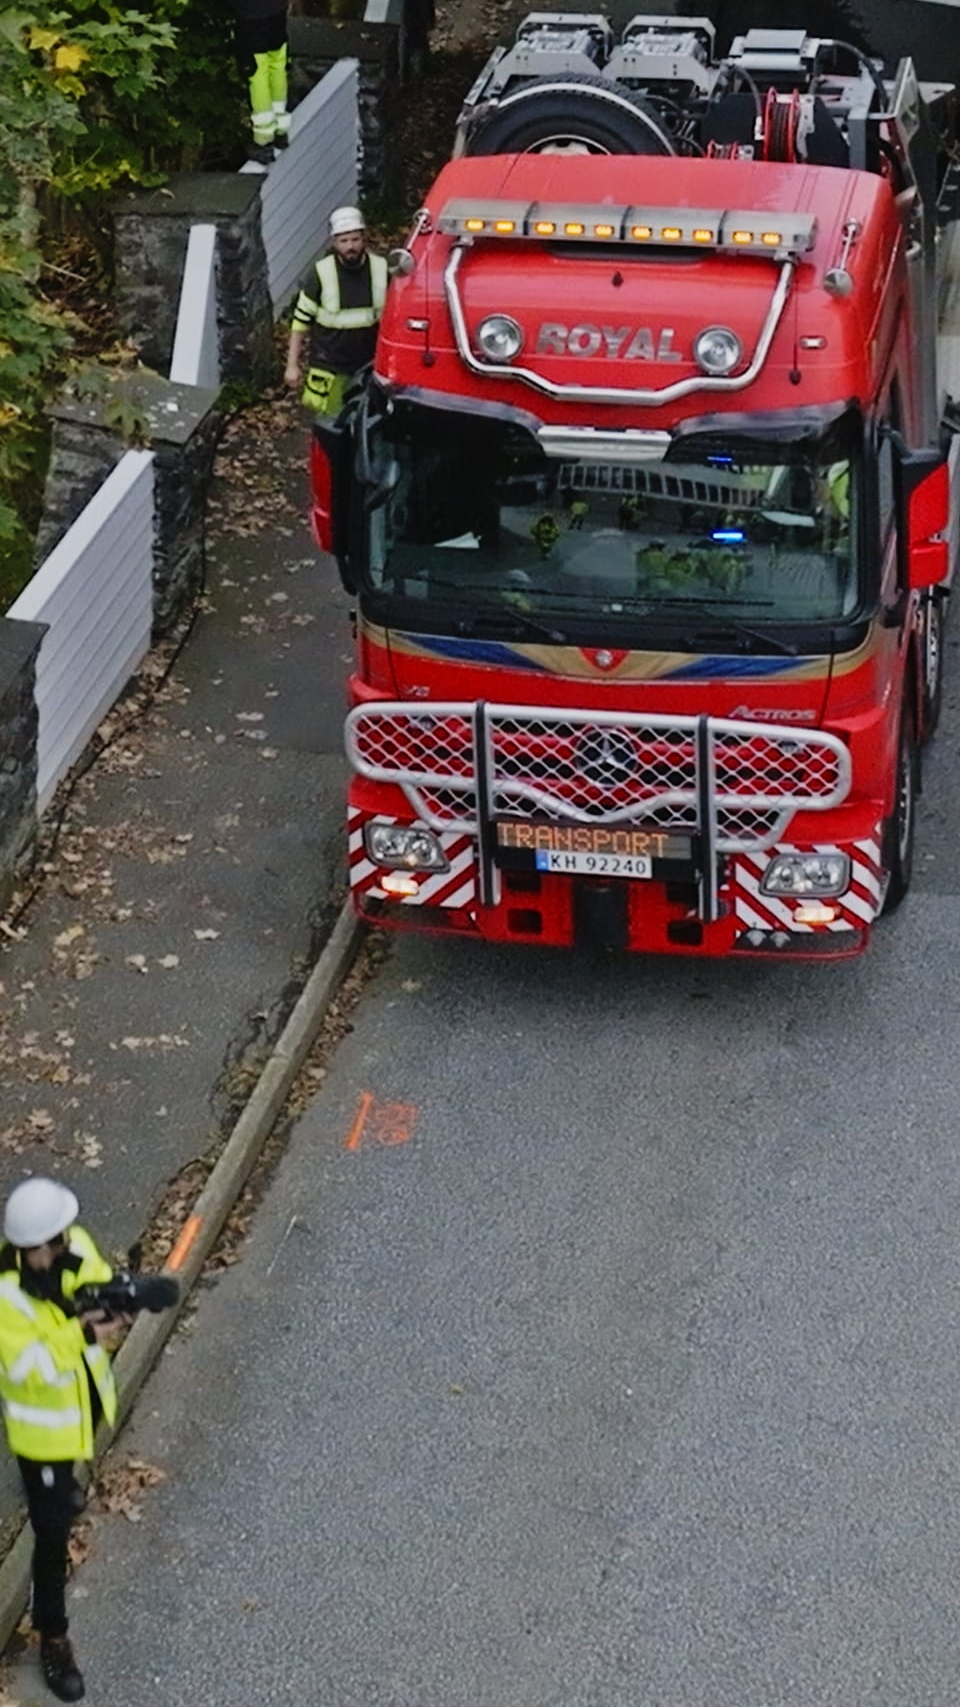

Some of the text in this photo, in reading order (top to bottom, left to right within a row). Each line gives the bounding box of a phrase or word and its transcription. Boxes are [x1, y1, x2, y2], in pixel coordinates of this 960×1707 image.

[535, 321, 683, 363] ROYAL
[497, 822, 669, 859] TRANSPORT
[550, 853, 647, 874] KH 92240
